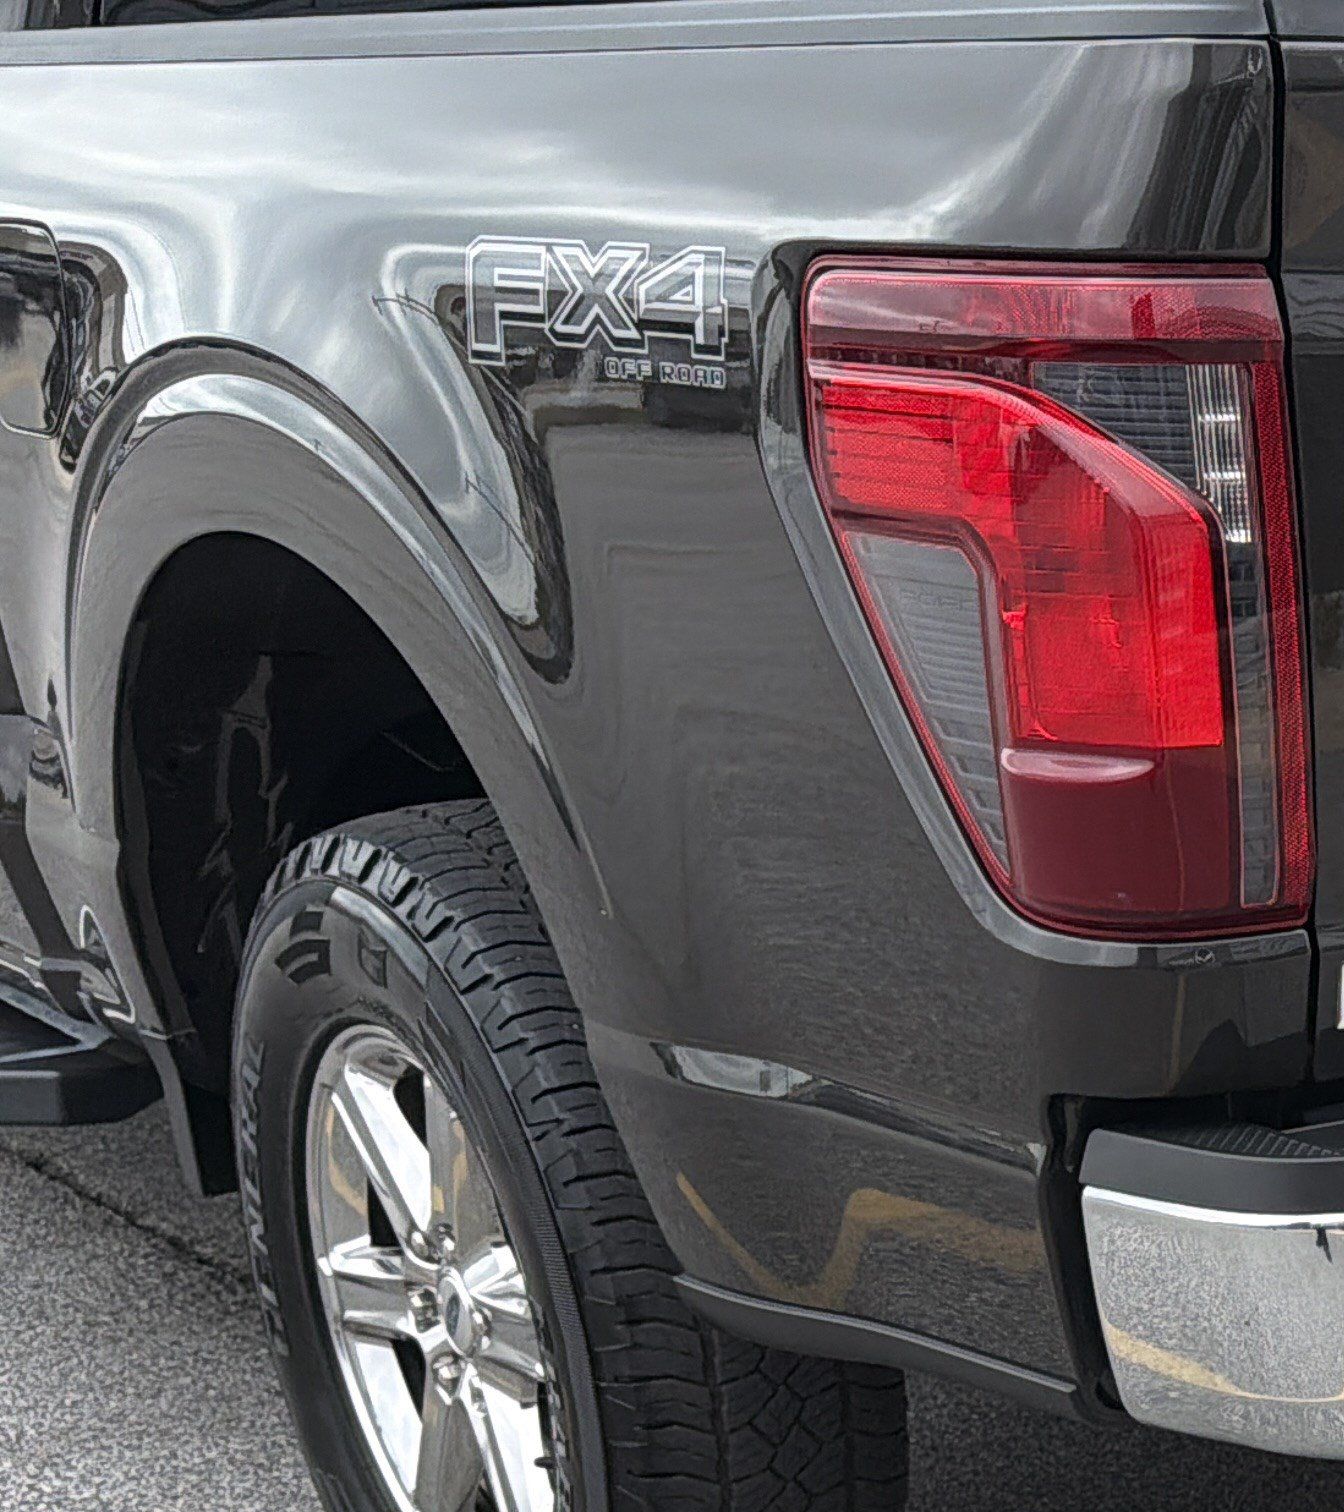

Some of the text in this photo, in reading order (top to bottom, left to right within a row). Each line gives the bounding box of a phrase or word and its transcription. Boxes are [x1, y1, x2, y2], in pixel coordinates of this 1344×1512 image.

[465, 235, 728, 365] FX4
[604, 357, 726, 389] OFF ROAD
